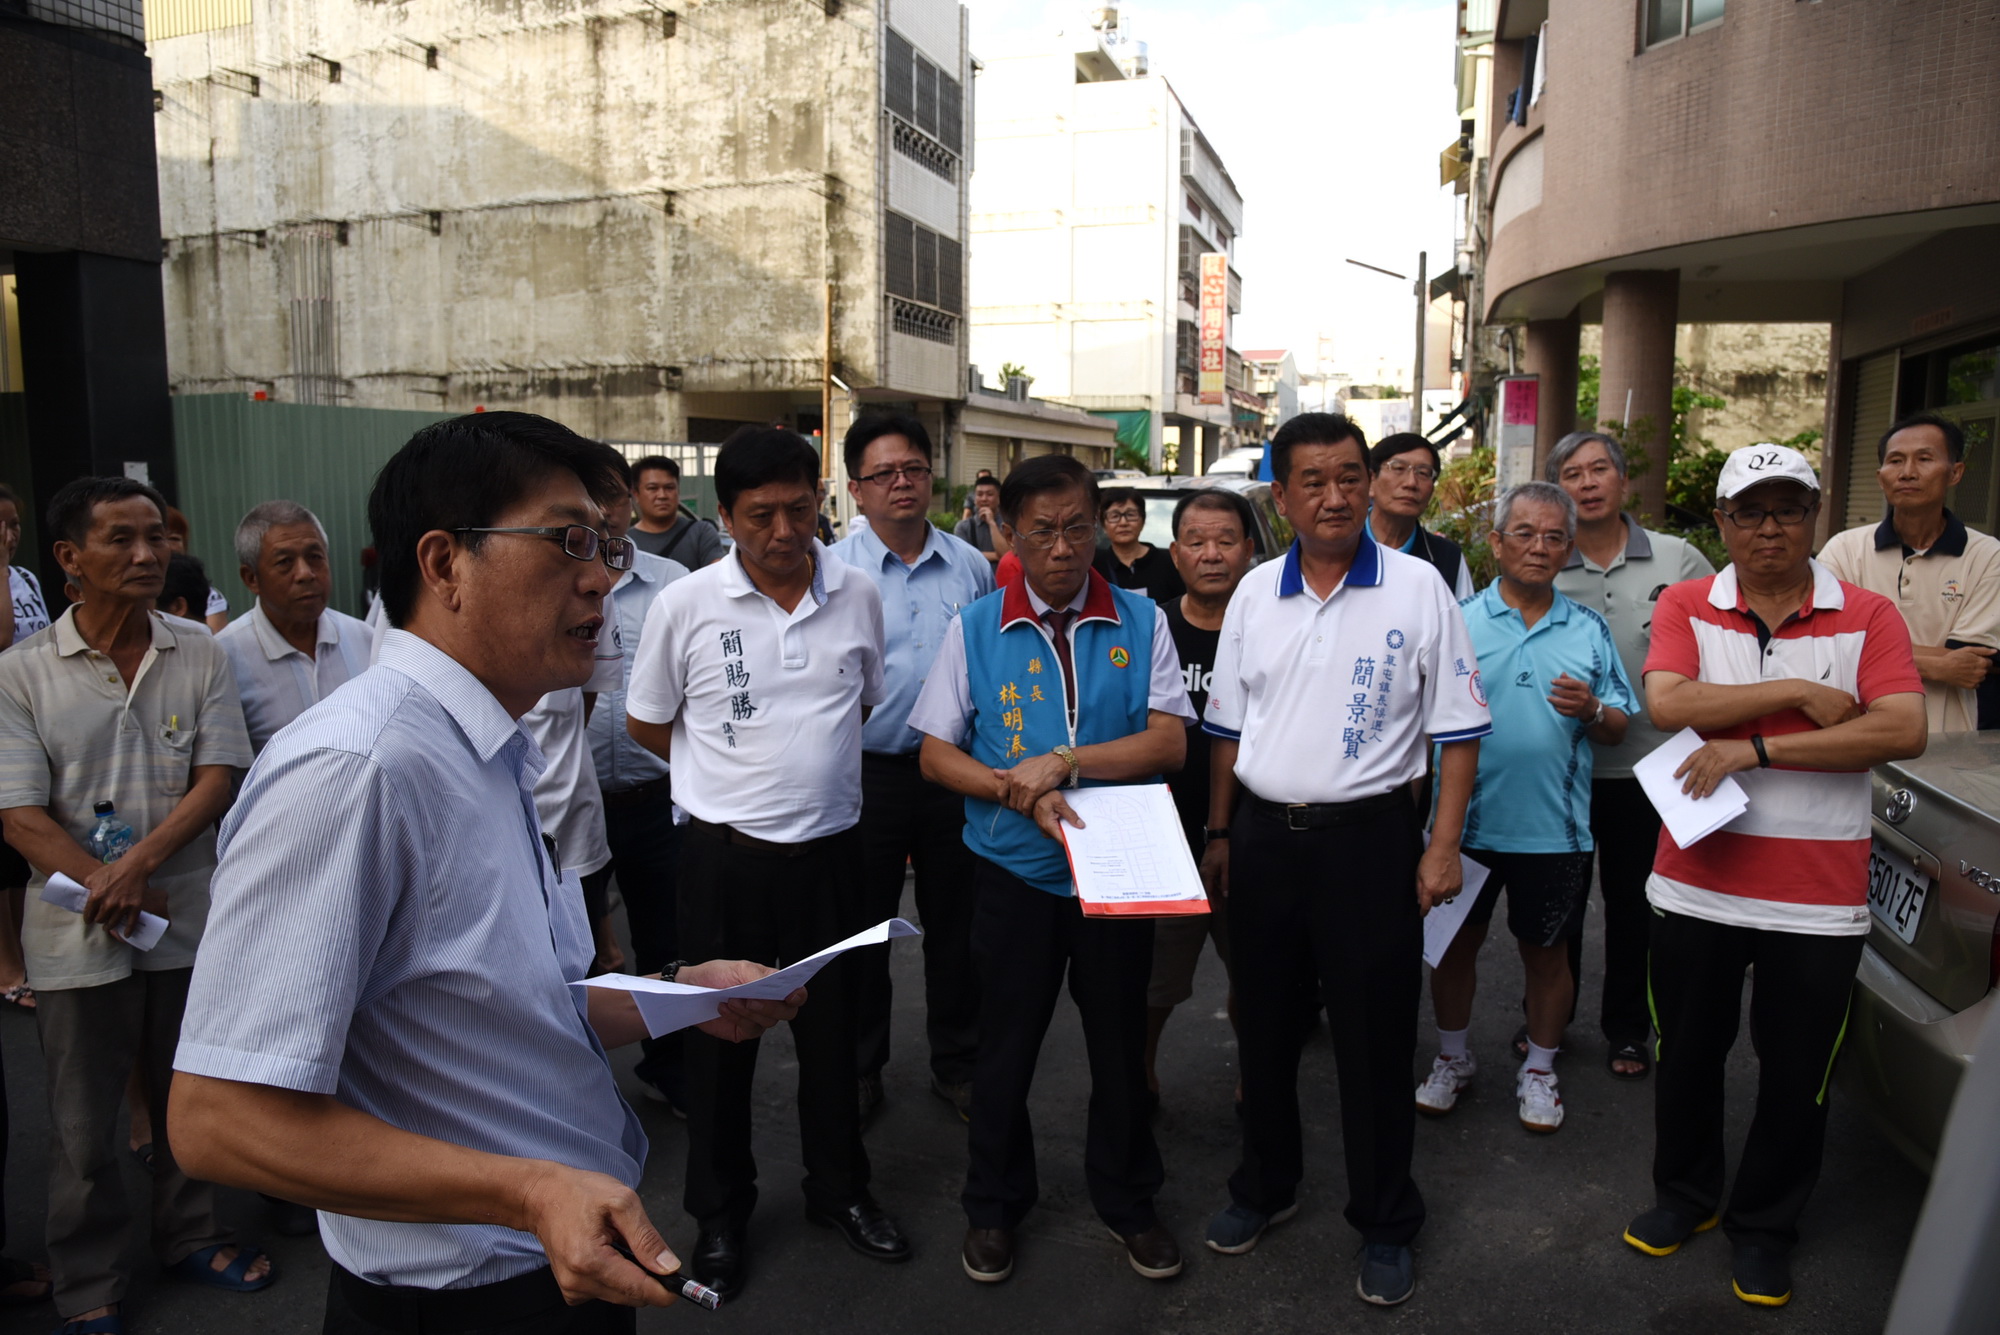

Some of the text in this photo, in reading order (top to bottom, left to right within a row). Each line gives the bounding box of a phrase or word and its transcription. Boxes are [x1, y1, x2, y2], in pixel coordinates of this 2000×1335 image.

[1748, 451, 1783, 471] QZ
[720, 629, 758, 749] 簡賜勝 議員
[999, 682, 1028, 759] 林明溱
[1027, 657, 1045, 702] 縣長
[1342, 656, 1376, 760] 簡景賢
[1368, 654, 1397, 742] 草屯鎮長候選人
